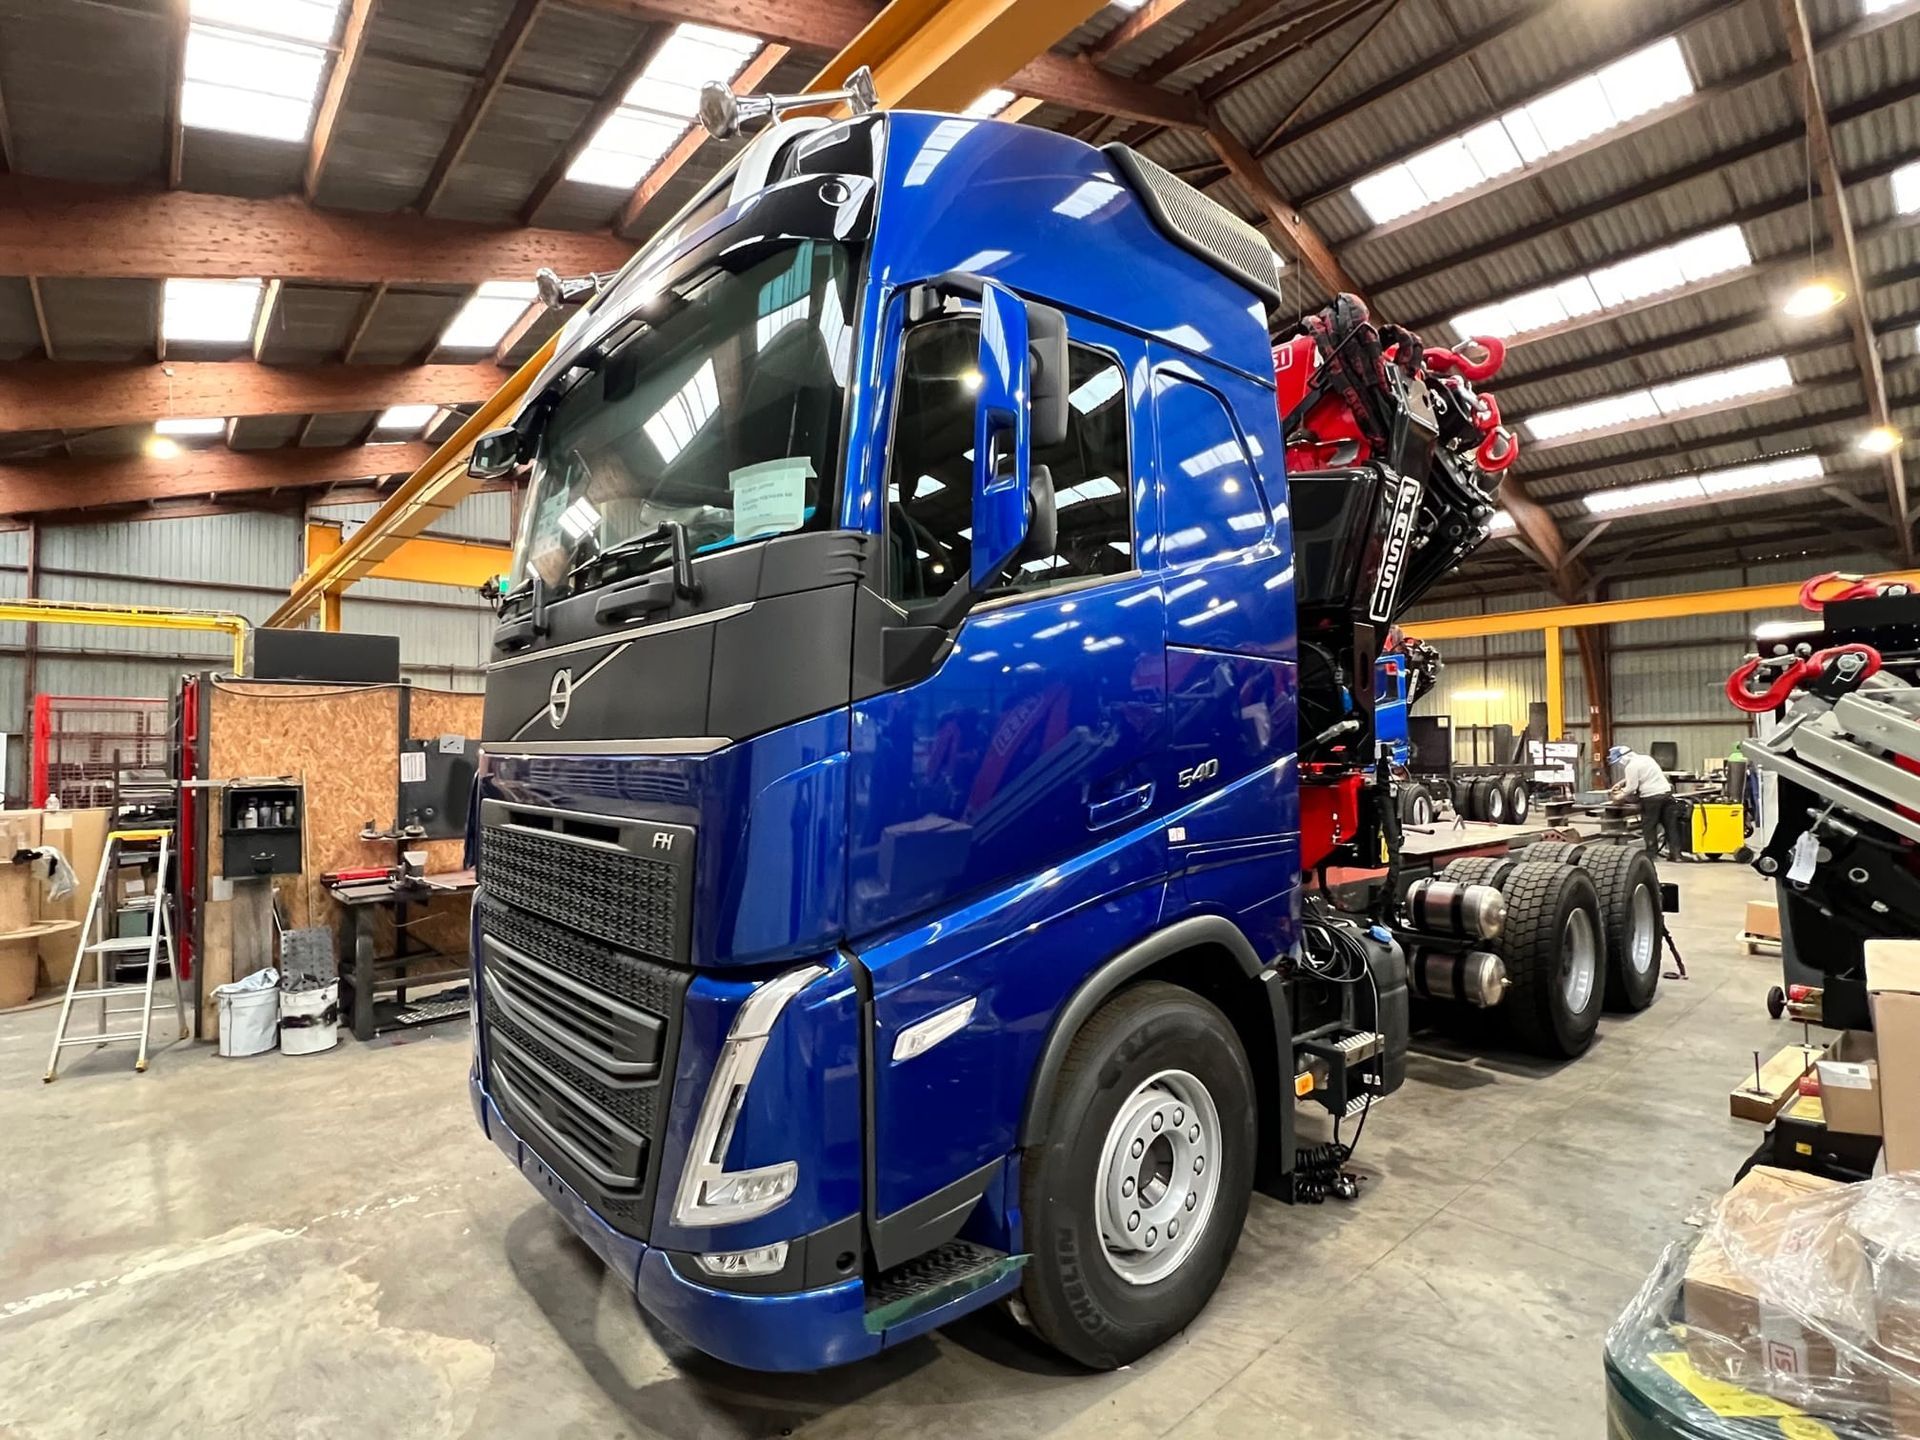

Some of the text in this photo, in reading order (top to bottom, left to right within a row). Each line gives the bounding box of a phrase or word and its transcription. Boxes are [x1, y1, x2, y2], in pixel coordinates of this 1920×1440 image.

[1378, 485, 1417, 613] FASSI
[1178, 758, 1219, 788] 540
[652, 832, 675, 850] FH
